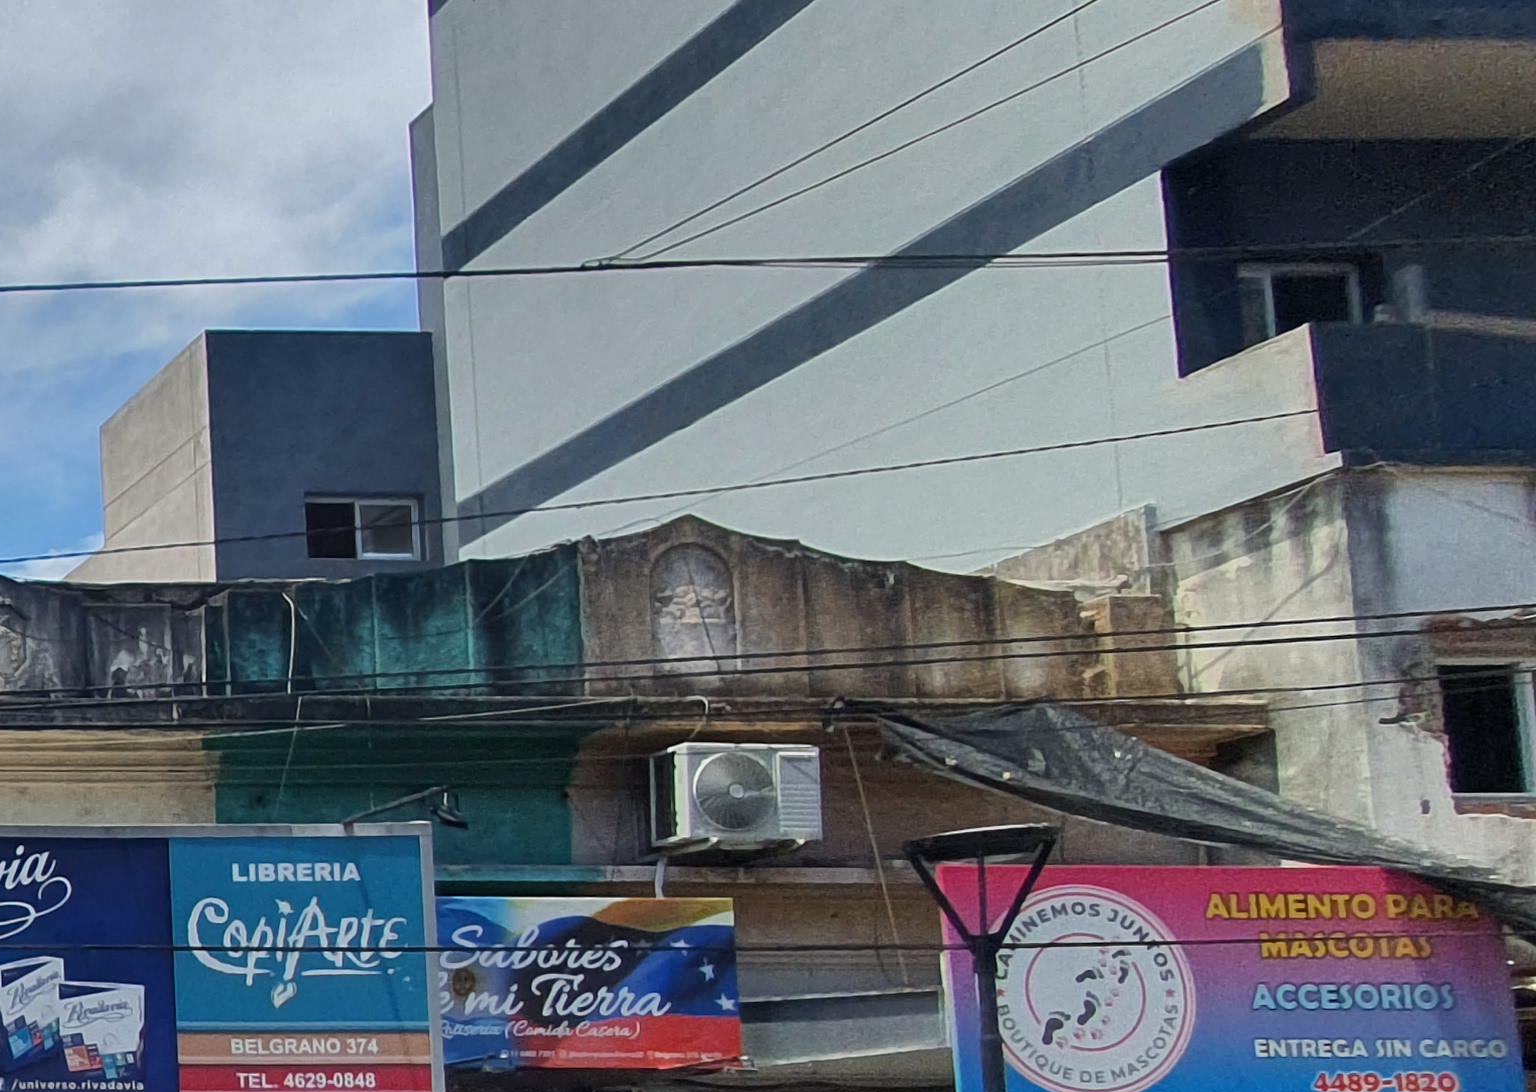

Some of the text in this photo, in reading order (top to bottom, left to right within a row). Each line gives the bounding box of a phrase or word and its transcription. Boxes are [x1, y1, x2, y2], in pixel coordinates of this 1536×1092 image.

[232, 863, 361, 882] LIBRERIA
[1206, 893, 1480, 920] ALIMENTO PARA
[439, 924, 630, 970] Sabores
[997, 902, 1101, 980] CAMINEMOS
[1260, 930, 1432, 958] MASCOTAS
[465, 983, 525, 1016] mi
[530, 973, 671, 1017] Tierra
[1252, 983, 1455, 1010] ACCESORIOS
[230, 1038, 379, 1056] BELGRANO 374
[998, 1004, 1074, 1080] BOUTIQUE
[1110, 1004, 1178, 1082] MASCOTAS
[1254, 1039, 1508, 1059] ENTREGA SIN CARGO
[236, 1072, 377, 1089] TEL. 4629-0848
[1080, 1070, 1107, 1084] DE
